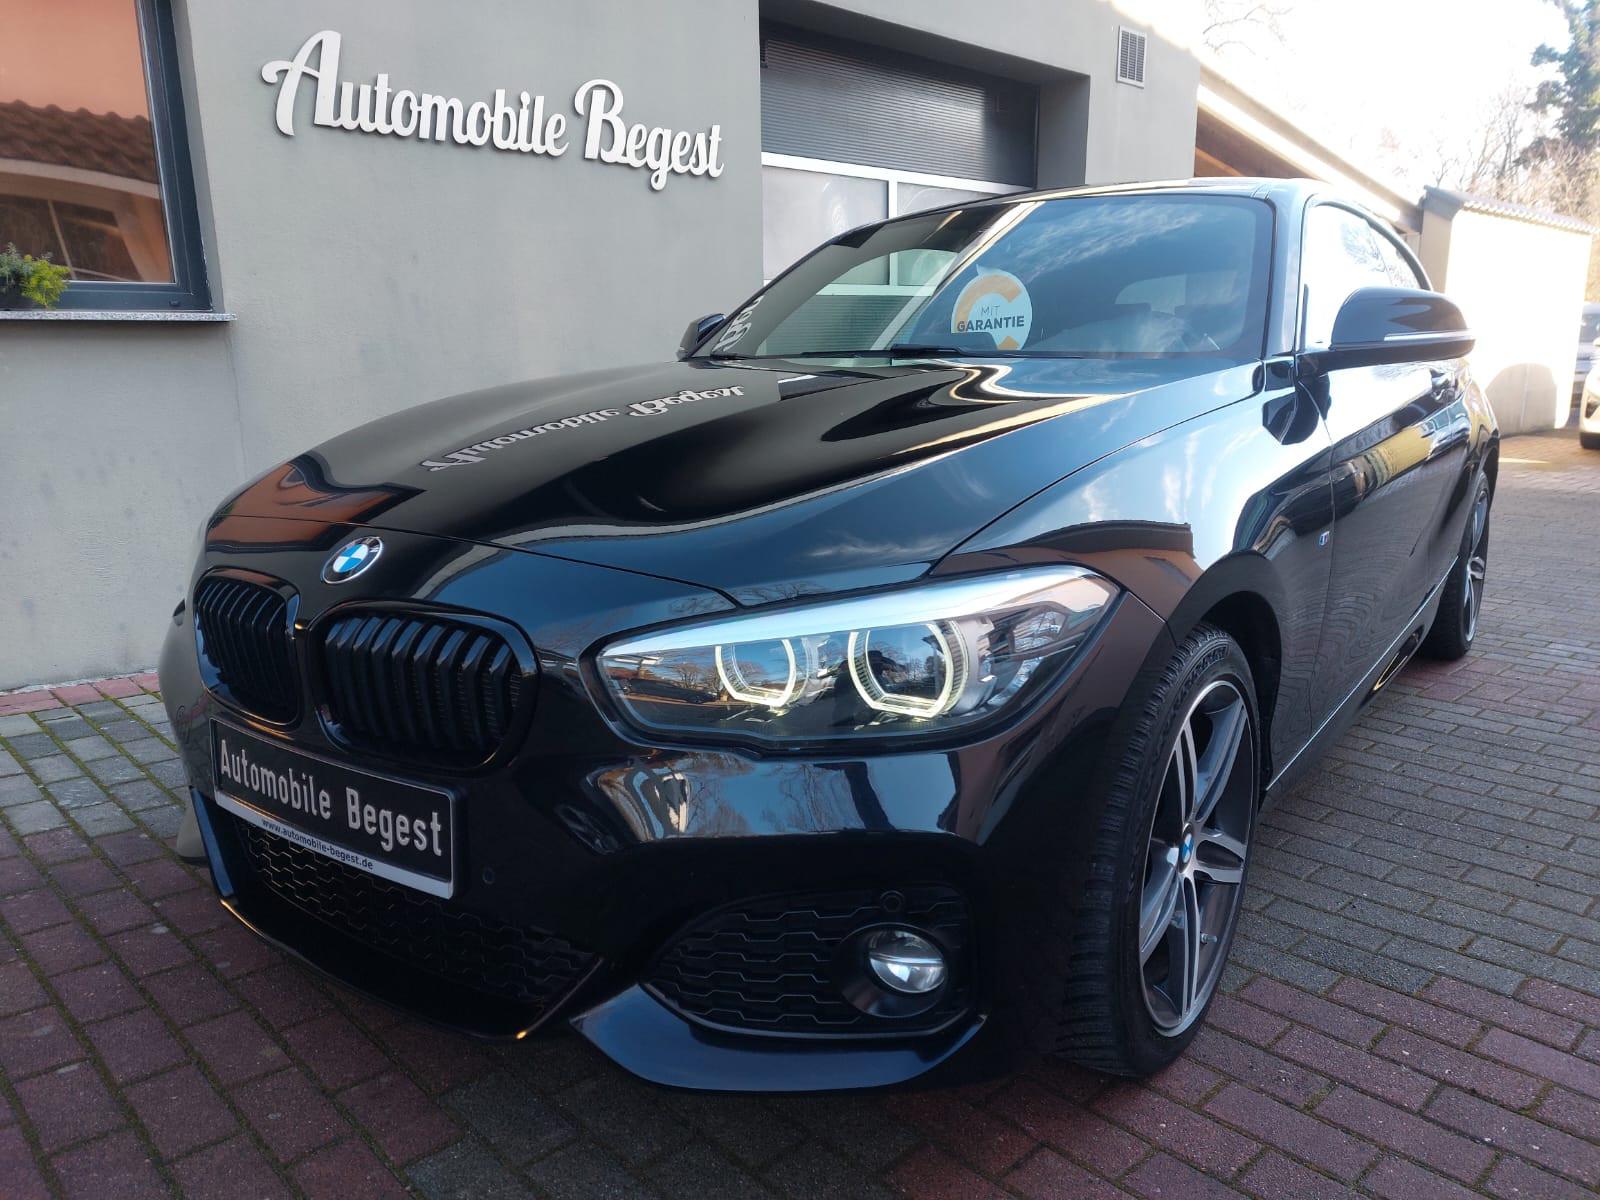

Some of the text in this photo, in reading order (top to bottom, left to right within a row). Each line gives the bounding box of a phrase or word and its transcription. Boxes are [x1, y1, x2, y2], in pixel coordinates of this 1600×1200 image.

[261, 29, 725, 191] Automobile Begest
[956, 315, 1025, 332] GARANTIE
[981, 304, 1001, 316] MIT
[220, 738, 443, 857] Automobile Begest
[261, 819, 375, 870] www.automobile-begest.de
